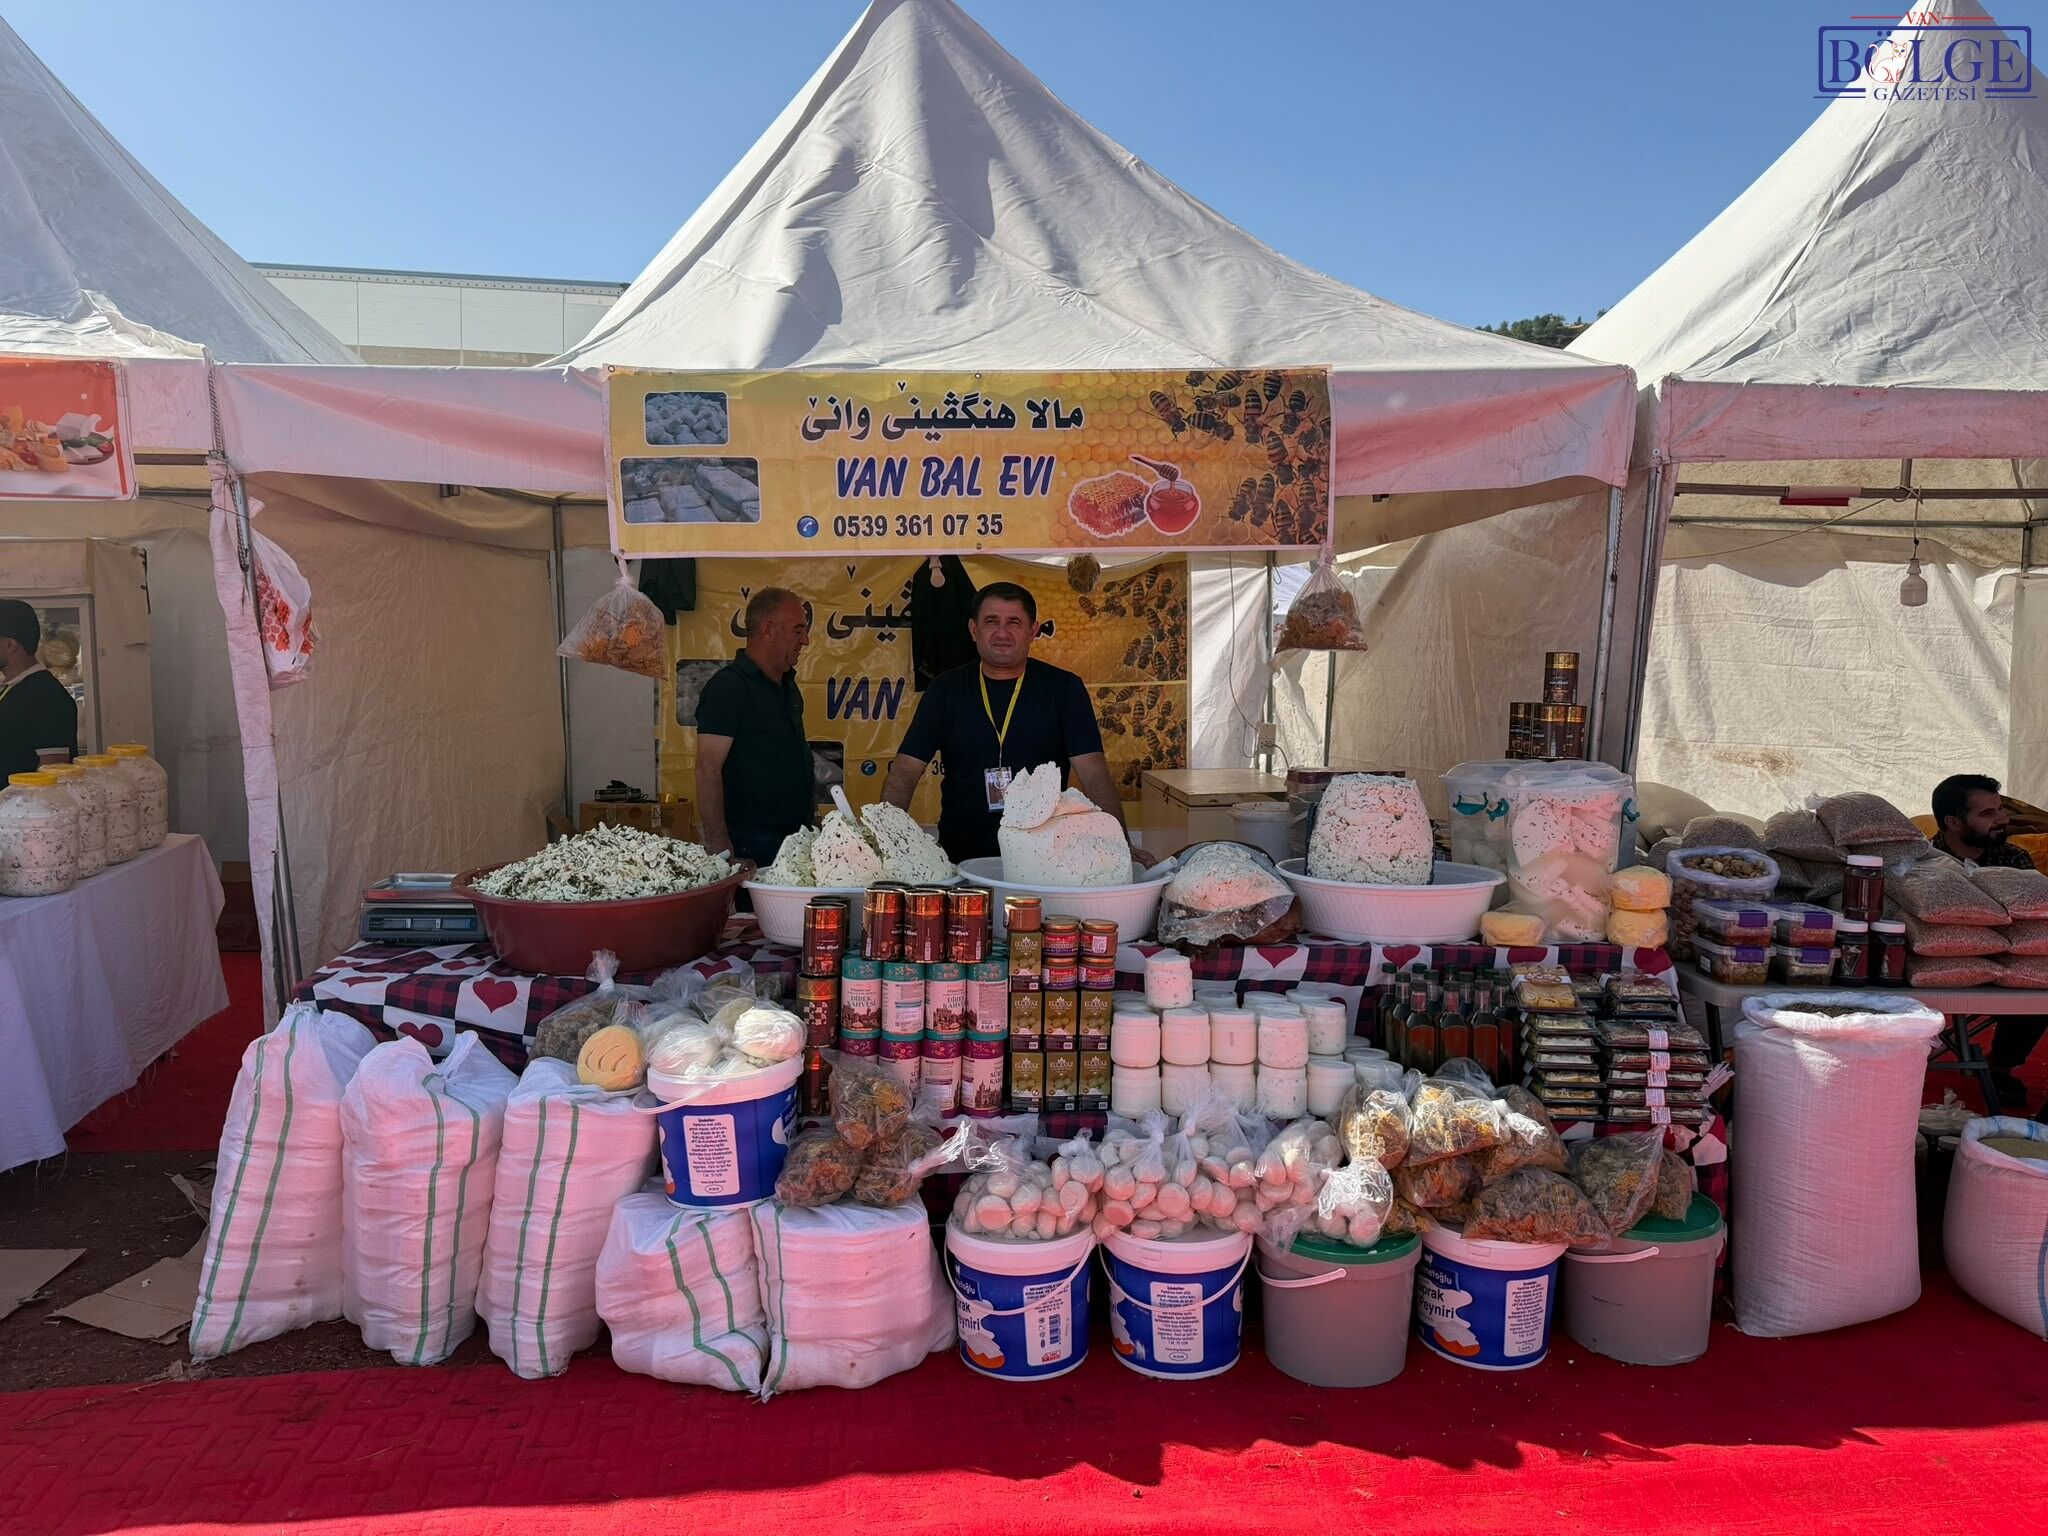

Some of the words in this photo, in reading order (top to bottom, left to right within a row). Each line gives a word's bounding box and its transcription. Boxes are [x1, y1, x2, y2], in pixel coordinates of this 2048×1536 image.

[1026, 398, 1084, 429] مالا
[837, 456, 909, 498] VAN
[920, 456, 982, 497] BAL
[998, 455, 1055, 497] EVI
[833, 515, 888, 537] 0539
[895, 514, 934, 536] 361
[942, 514, 969, 536] 07
[976, 513, 1003, 536] 35
[827, 676, 905, 720] VAN
